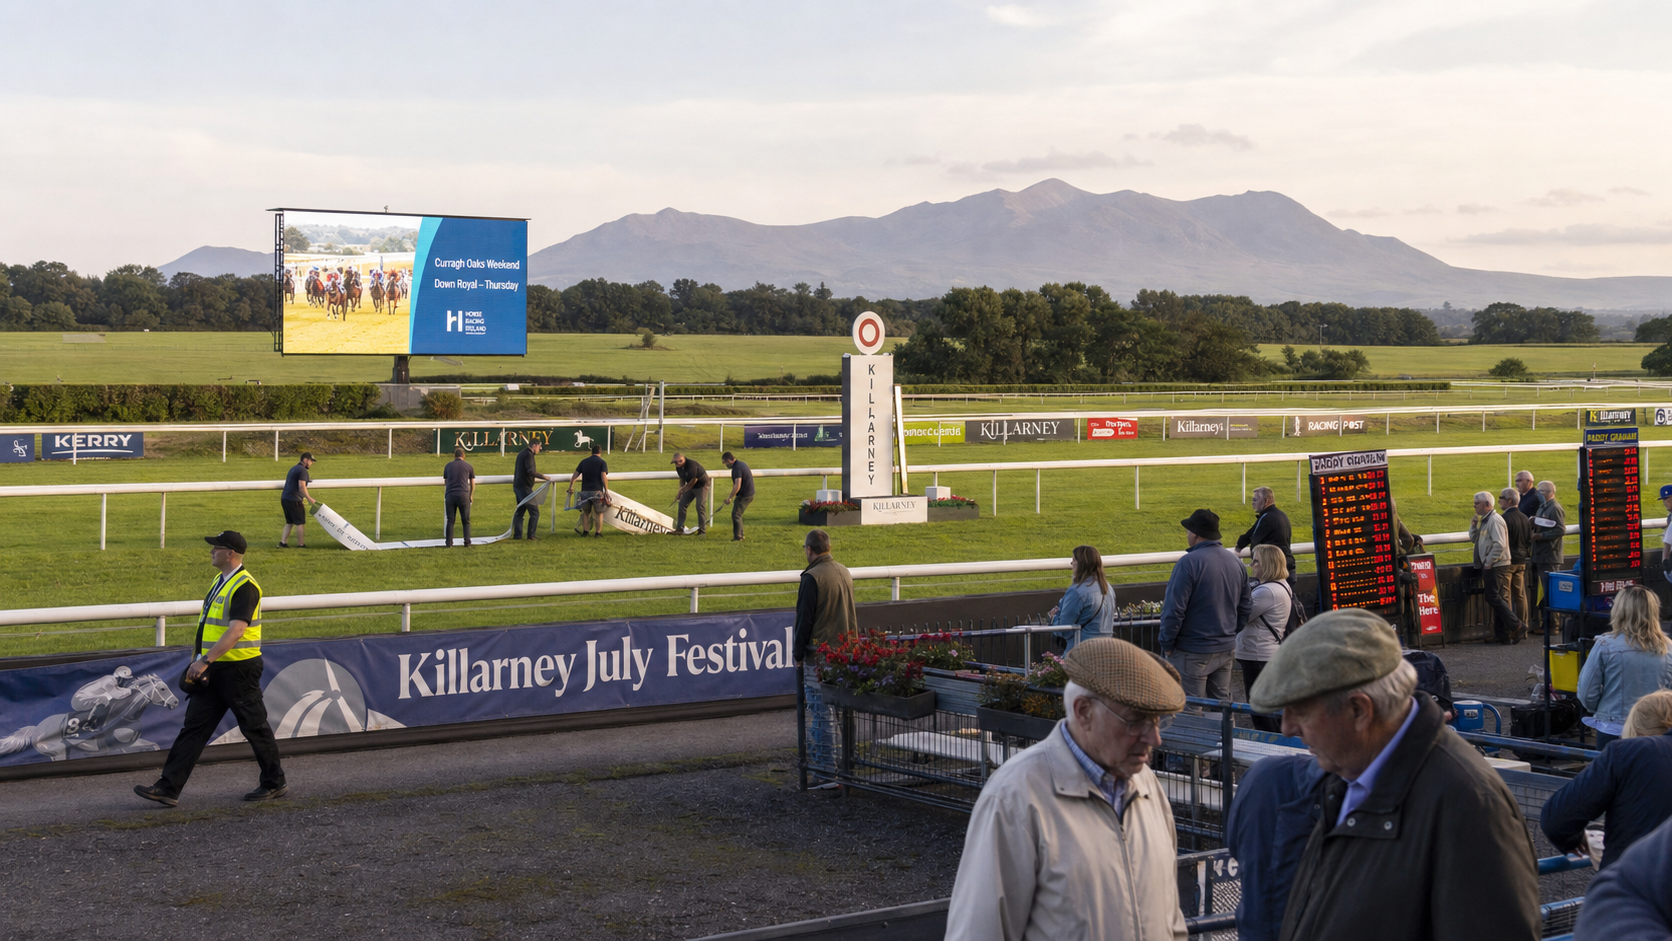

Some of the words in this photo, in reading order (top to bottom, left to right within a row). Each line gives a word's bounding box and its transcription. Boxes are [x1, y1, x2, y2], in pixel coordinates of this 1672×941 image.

[434, 257, 465, 270] Curragh
[466, 258, 485, 269] Oaks
[486, 259, 520, 270] Weekend
[434, 278, 456, 289] Down
[457, 279, 478, 291] Royal
[484, 279, 519, 292] Thursday
[868, 363, 876, 486] KILLARNEY
[980, 421, 1060, 440] KILLARNEY
[1308, 420, 1339, 431] RACING
[1343, 420, 1365, 430] POST
[54, 434, 133, 448] KERRY
[873, 501, 916, 512] KILLARNEY
[1417, 593, 1436, 603] The
[1419, 606, 1439, 616] Here
[397, 647, 578, 700] Killarney
[582, 635, 654, 692] July
[666, 626, 795, 677] Festival
